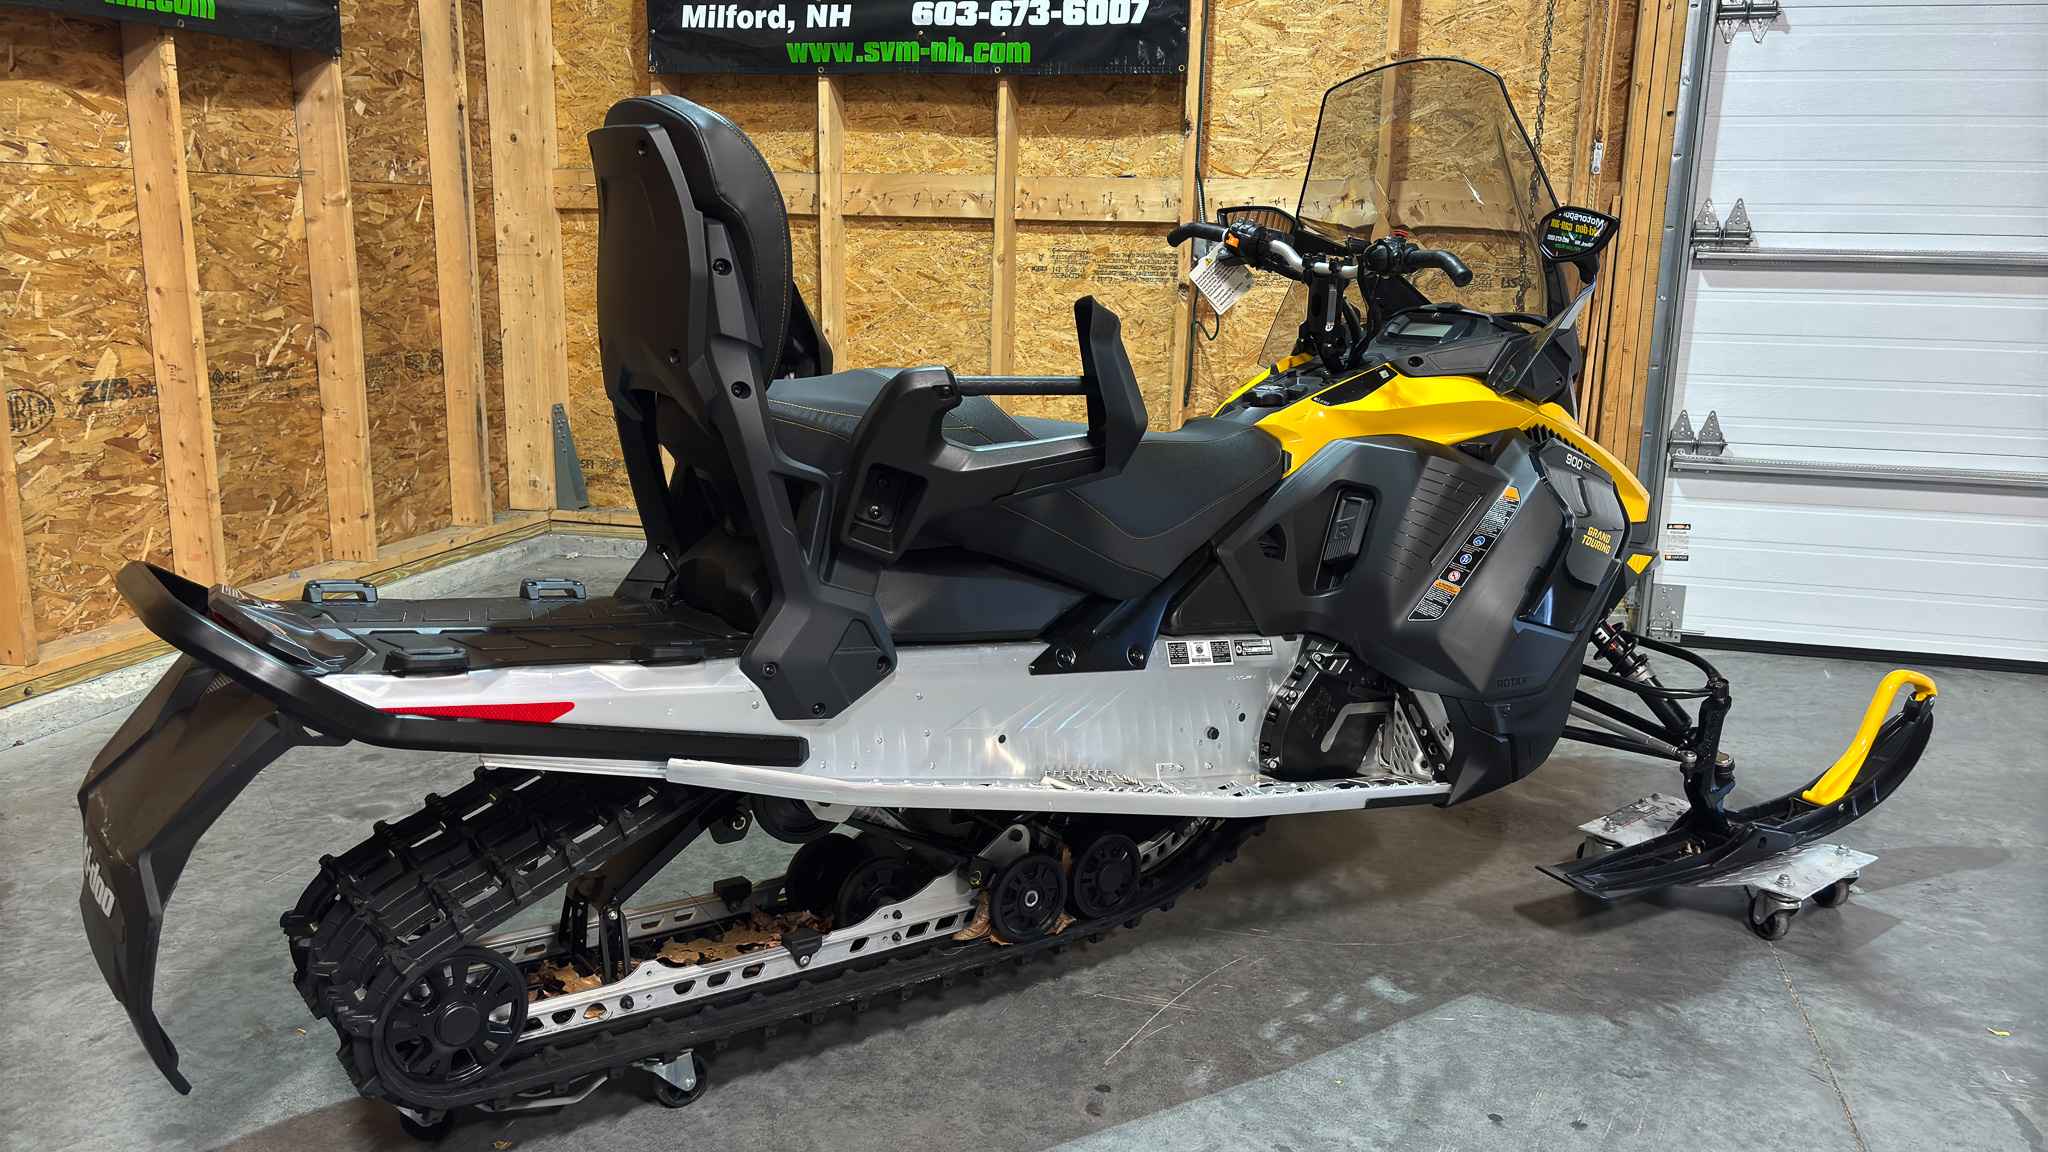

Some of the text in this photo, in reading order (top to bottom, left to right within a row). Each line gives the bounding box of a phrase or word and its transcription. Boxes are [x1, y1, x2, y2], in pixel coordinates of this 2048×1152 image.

[105, 0, 215, 20] .com
[681, 4, 852, 34] Milford, NH
[911, 0, 1149, 27] 603-673-6007
[786, 37, 1031, 63] www.svm-nh.com
[1565, 453, 1584, 471] 900
[1581, 534, 1612, 555] TOURING
[1587, 526, 1612, 544] GRAND
[1496, 675, 1528, 689] ROTAX
